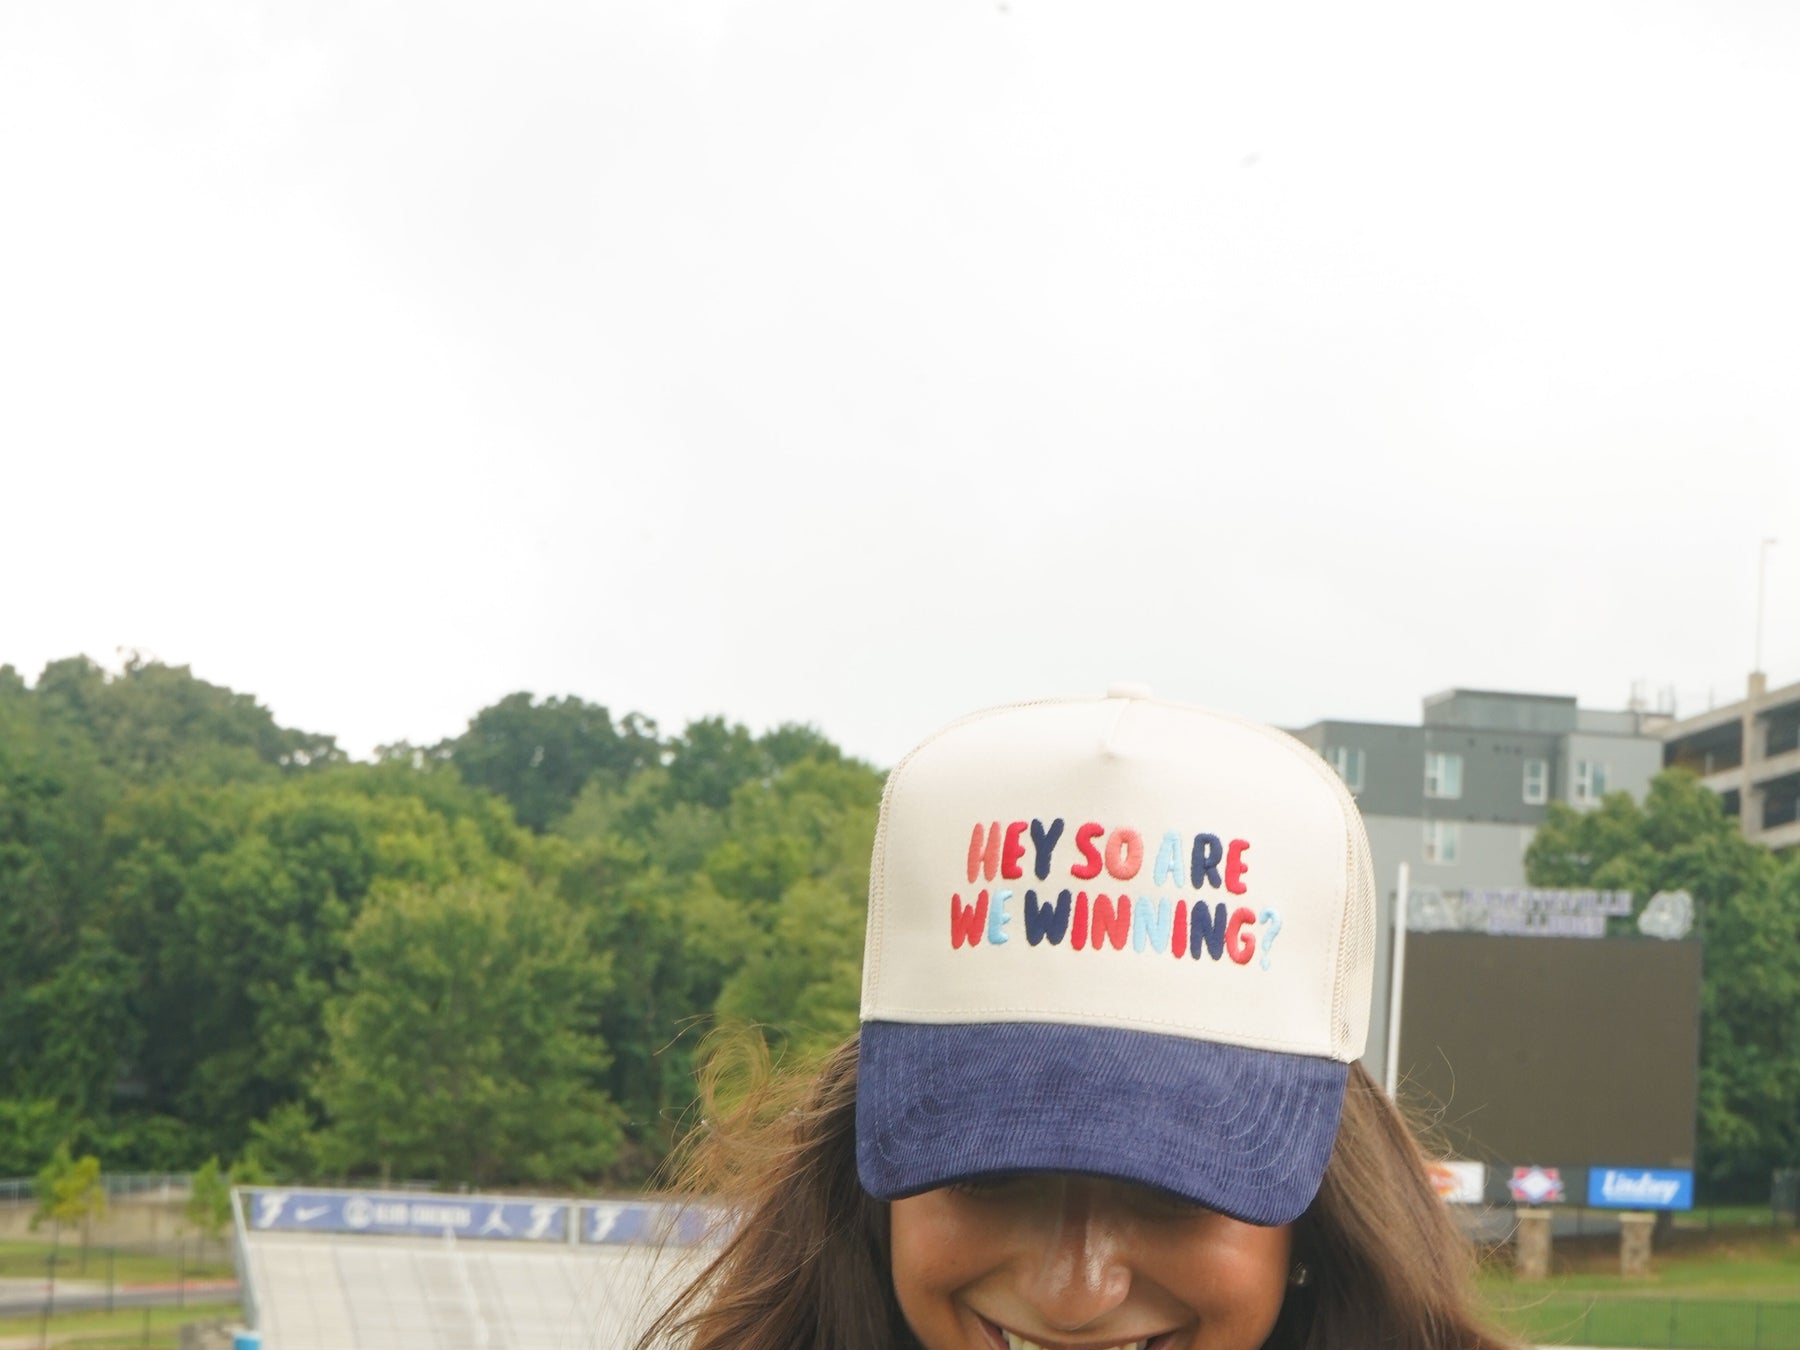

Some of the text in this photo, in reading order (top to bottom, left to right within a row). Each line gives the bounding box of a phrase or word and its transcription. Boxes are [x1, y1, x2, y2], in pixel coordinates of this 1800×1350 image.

[966, 817, 1251, 896] HEY SO ARE
[950, 888, 1282, 970] WE WINNING?
